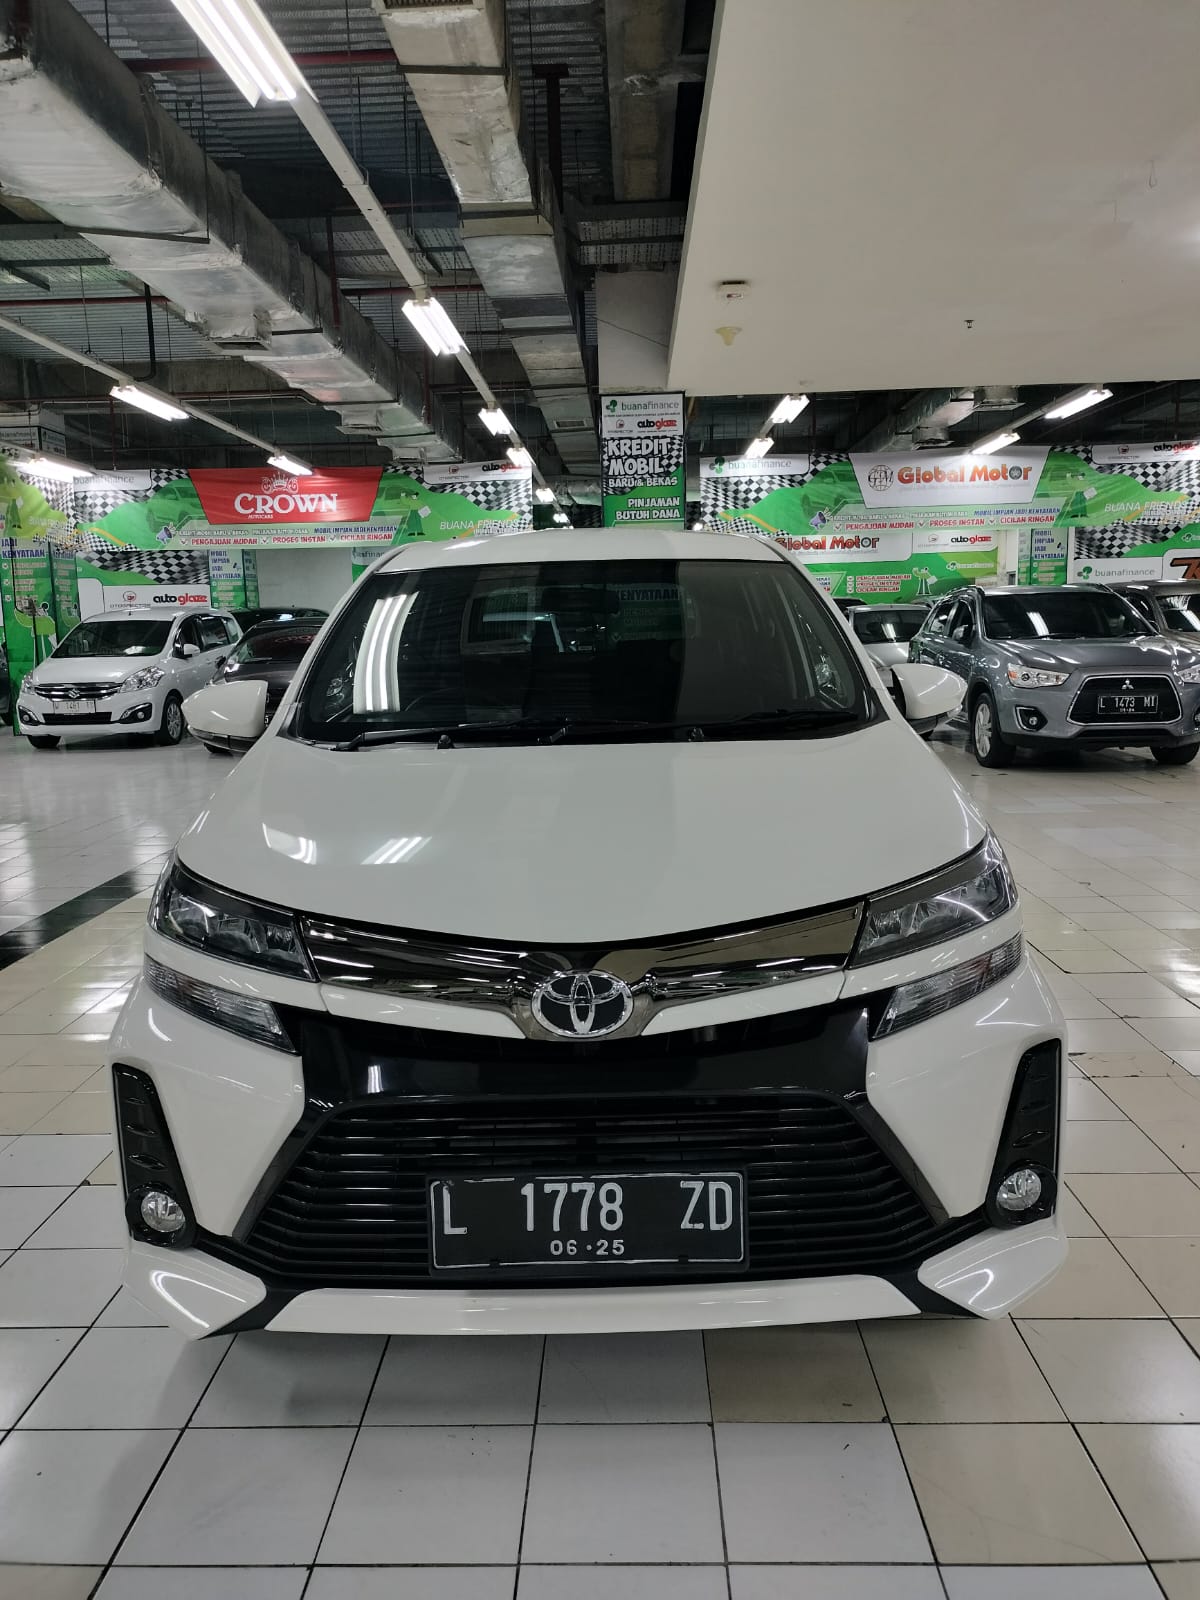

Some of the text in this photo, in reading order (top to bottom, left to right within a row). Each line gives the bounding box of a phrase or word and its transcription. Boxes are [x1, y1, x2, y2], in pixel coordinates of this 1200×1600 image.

[621, 401, 679, 411] buanafinance
[607, 438, 671, 456] KREDIT
[608, 457, 664, 475] MOBIL
[897, 464, 1032, 484] Global Motor
[608, 478, 635, 488] BARU
[646, 477, 678, 487] BEKAS
[234, 493, 338, 514] CROWN
[628, 497, 680, 507] PINJAMAN
[1105, 502, 1140, 512] BUANA
[616, 509, 680, 520] BUTUH DANA
[440, 521, 474, 530] BUANA
[830, 535, 880, 550] Motor
[2, 549, 45, 558] KENYATAAN
[1095, 569, 1155, 577] buanafinance
[153, 593, 207, 605] autoglaze
[1100, 697, 1106, 708] L
[1115, 697, 1135, 708] 1473
[443, 1180, 733, 1235] L 1778 ZD
